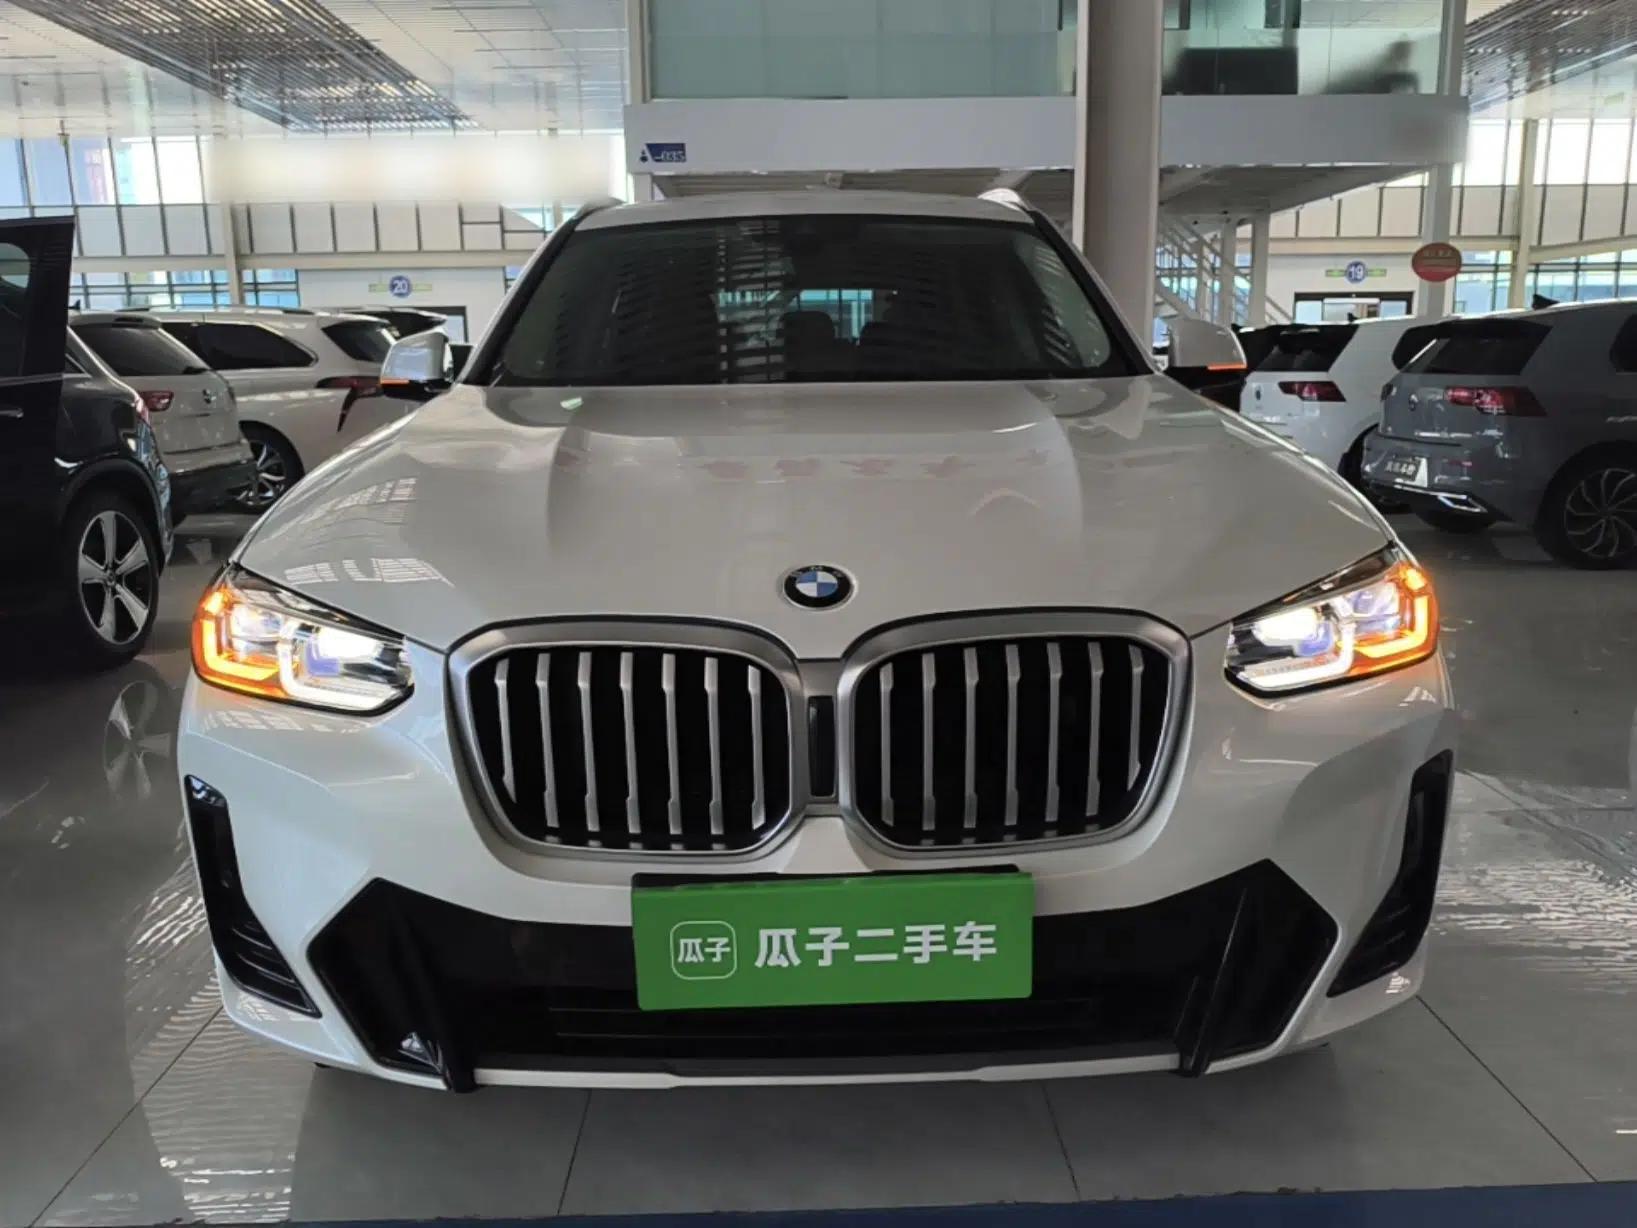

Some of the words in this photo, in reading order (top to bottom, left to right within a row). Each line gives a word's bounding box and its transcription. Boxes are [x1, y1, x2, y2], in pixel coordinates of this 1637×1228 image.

[1349, 265, 1364, 280] 19
[393, 279, 409, 295] 20
[677, 937, 732, 963] 瓜子
[754, 920, 998, 968] 瓜子二手车
